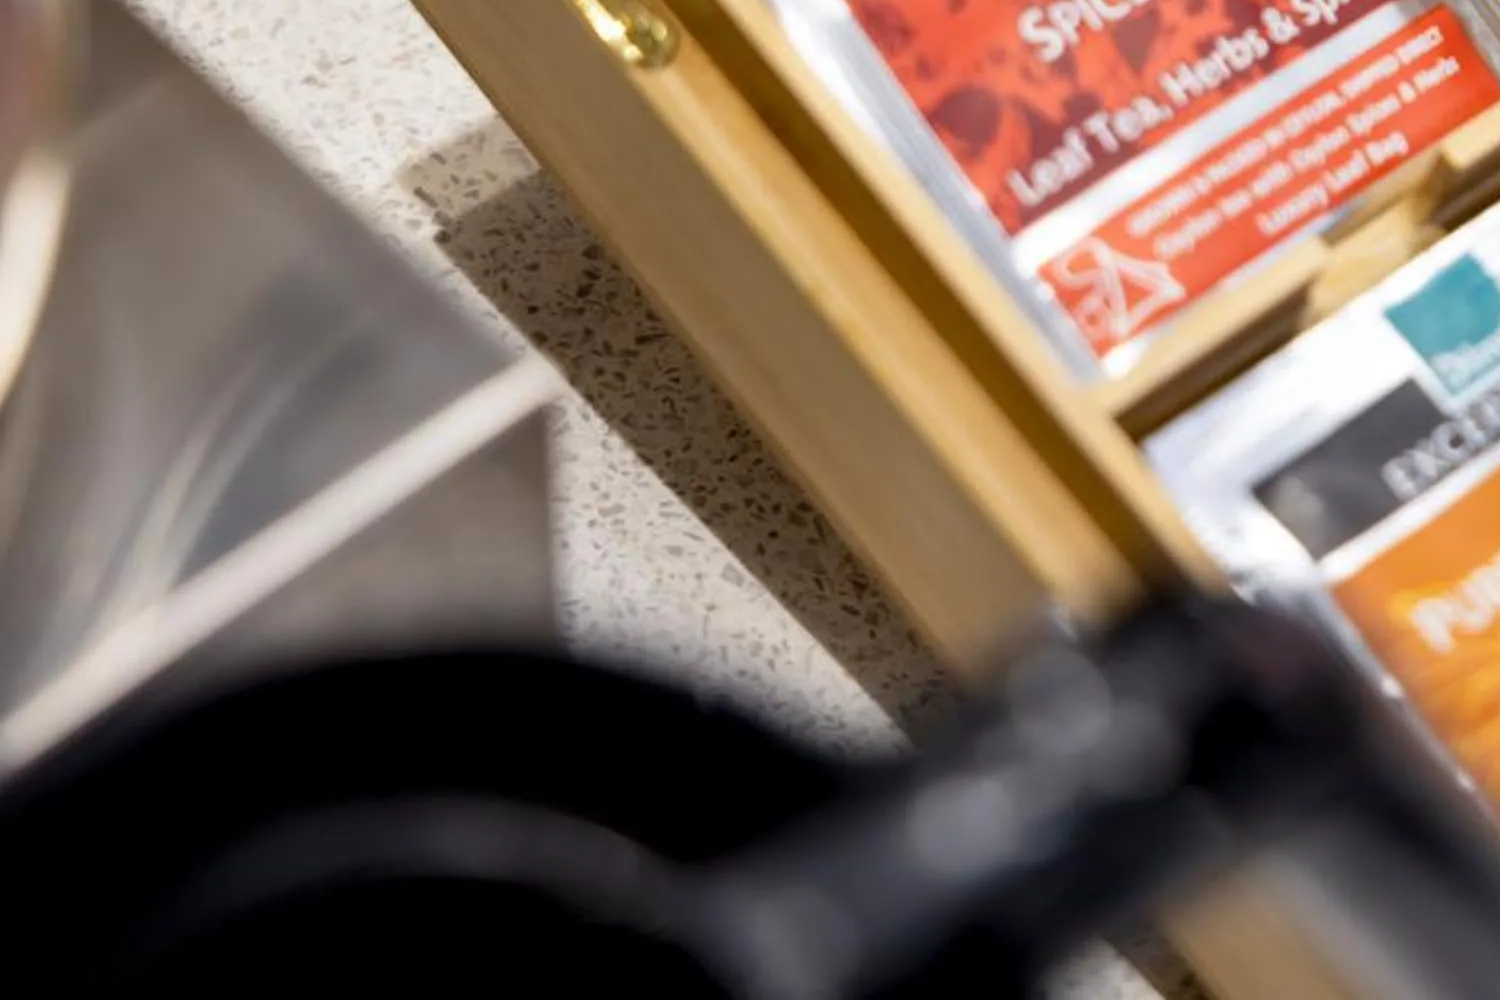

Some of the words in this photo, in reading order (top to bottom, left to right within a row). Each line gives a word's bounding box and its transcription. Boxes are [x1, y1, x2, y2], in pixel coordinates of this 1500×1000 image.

[1004, 129, 1096, 207] Leaf
[1086, 95, 1175, 152] Tea,
[1158, 27, 1271, 104] Herbs
[1260, 6, 1300, 45] &
